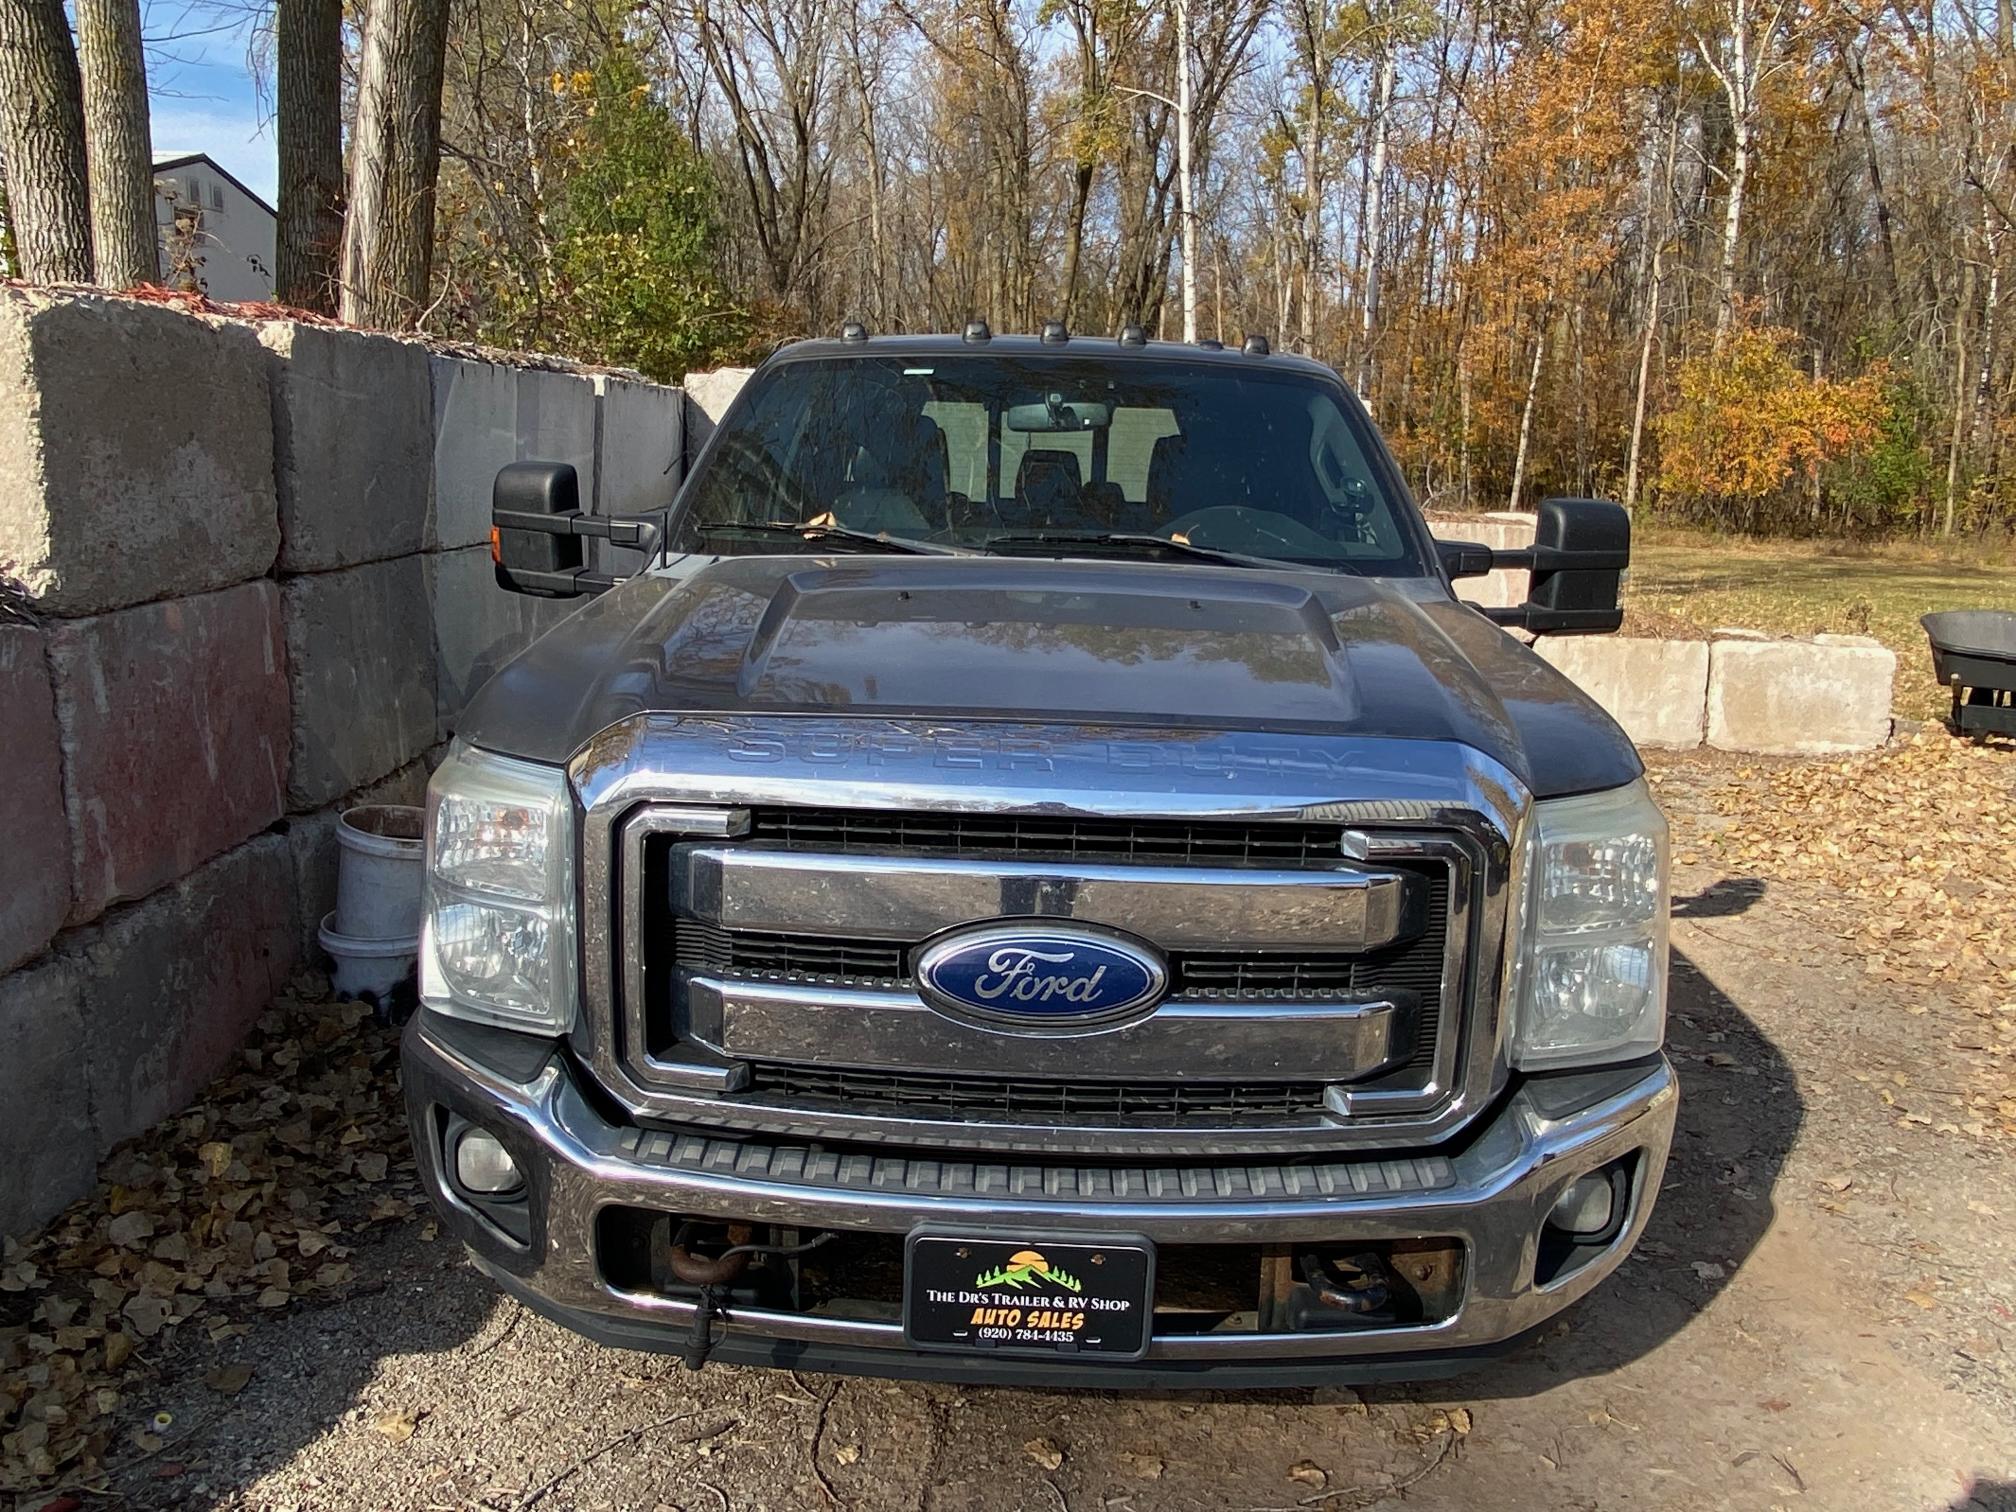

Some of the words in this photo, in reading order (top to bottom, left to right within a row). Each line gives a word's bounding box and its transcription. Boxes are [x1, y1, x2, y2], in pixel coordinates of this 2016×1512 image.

[974, 948, 1107, 1002] Ford
[927, 1289, 955, 1303] THE
[991, 1292, 1050, 1308] TRAILER
[1053, 1296, 1065, 1309] &
[1068, 1296, 1088, 1310] RV
[1091, 1297, 1130, 1311] SHOP
[970, 1307, 1020, 1328] AUTO
[1026, 1311, 1085, 1330] SALES
[978, 1327, 1012, 1341] (920)
[1015, 1328, 1074, 1343] 784-4435
